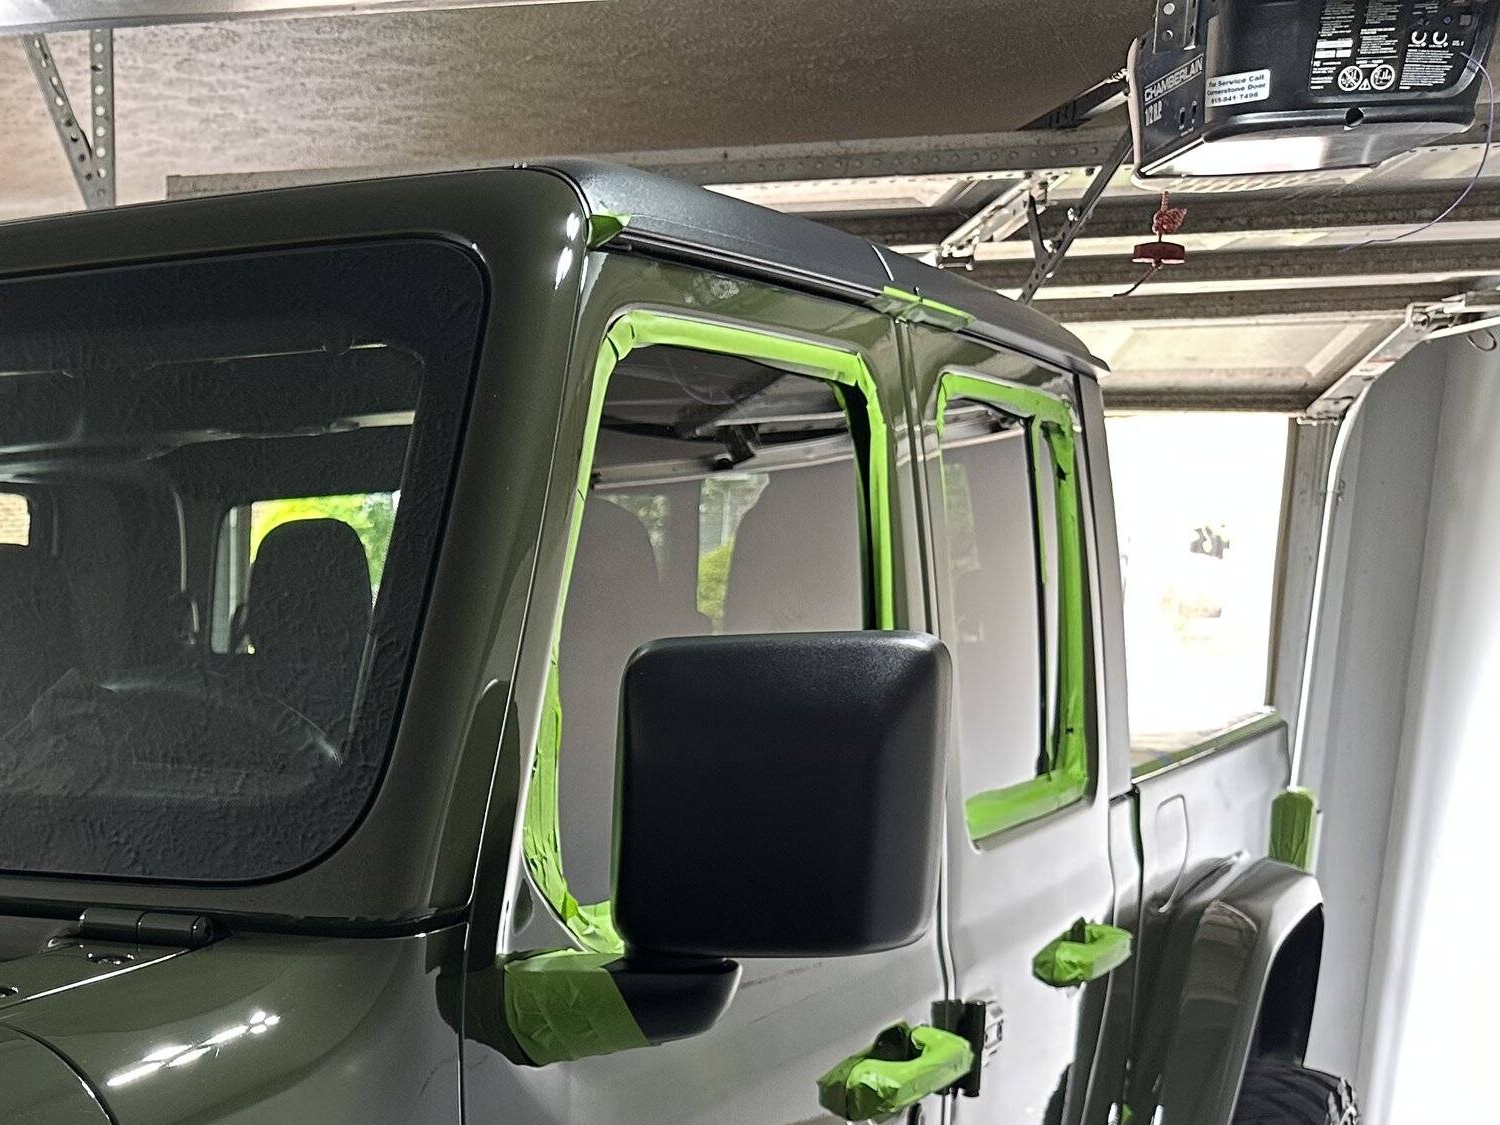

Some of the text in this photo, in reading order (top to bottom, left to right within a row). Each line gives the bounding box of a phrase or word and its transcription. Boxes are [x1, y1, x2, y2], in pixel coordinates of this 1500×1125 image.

[1144, 56, 1203, 102] CHAMBERLAIN
[1218, 78, 1246, 87] Service
[1248, 74, 1265, 82] Call
